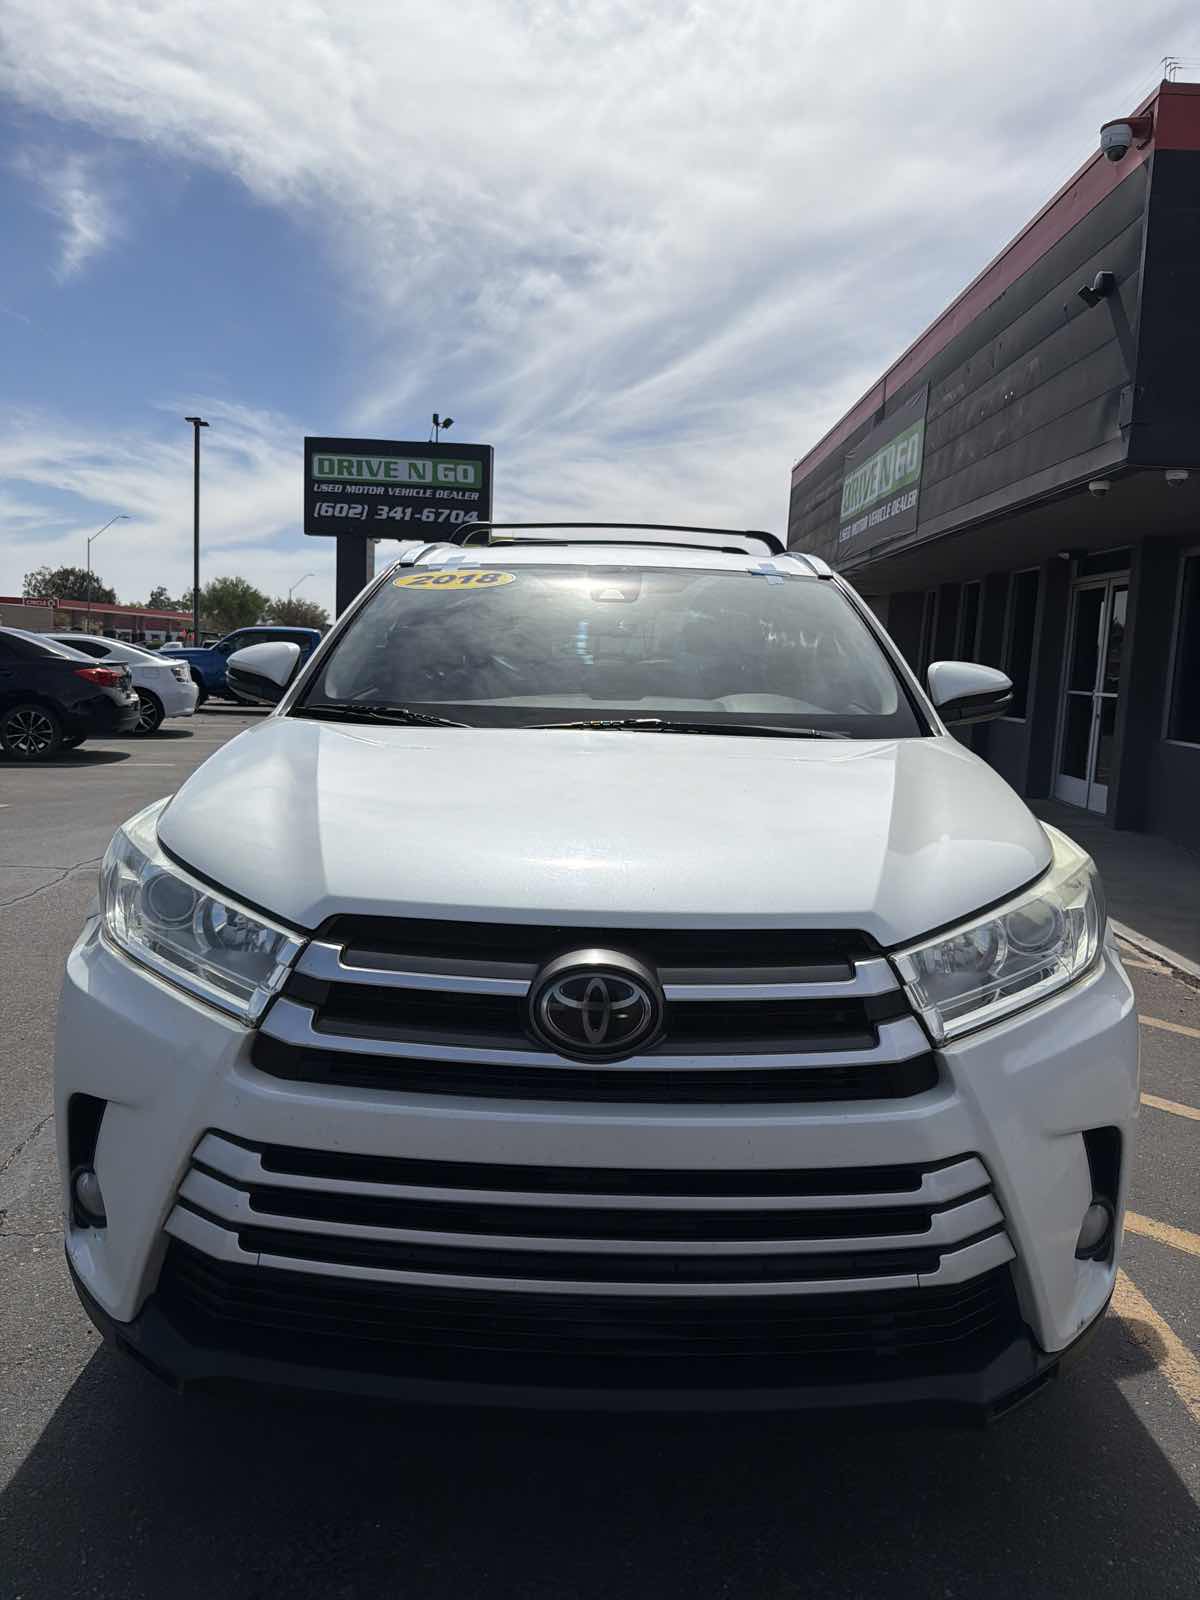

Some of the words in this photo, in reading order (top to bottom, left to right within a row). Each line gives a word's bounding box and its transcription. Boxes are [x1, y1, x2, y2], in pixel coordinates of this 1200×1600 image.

[317, 457, 401, 479] DRIVE
[408, 462, 426, 481] N
[437, 463, 475, 483] GO
[313, 484, 343, 493] USED
[345, 485, 385, 495] MOTOR
[388, 487, 433, 498] VEHICLE
[435, 490, 480, 500] DEALER
[313, 502, 368, 520] (602)
[374, 505, 479, 524] 341-6704
[406, 573, 500, 587] 2018
